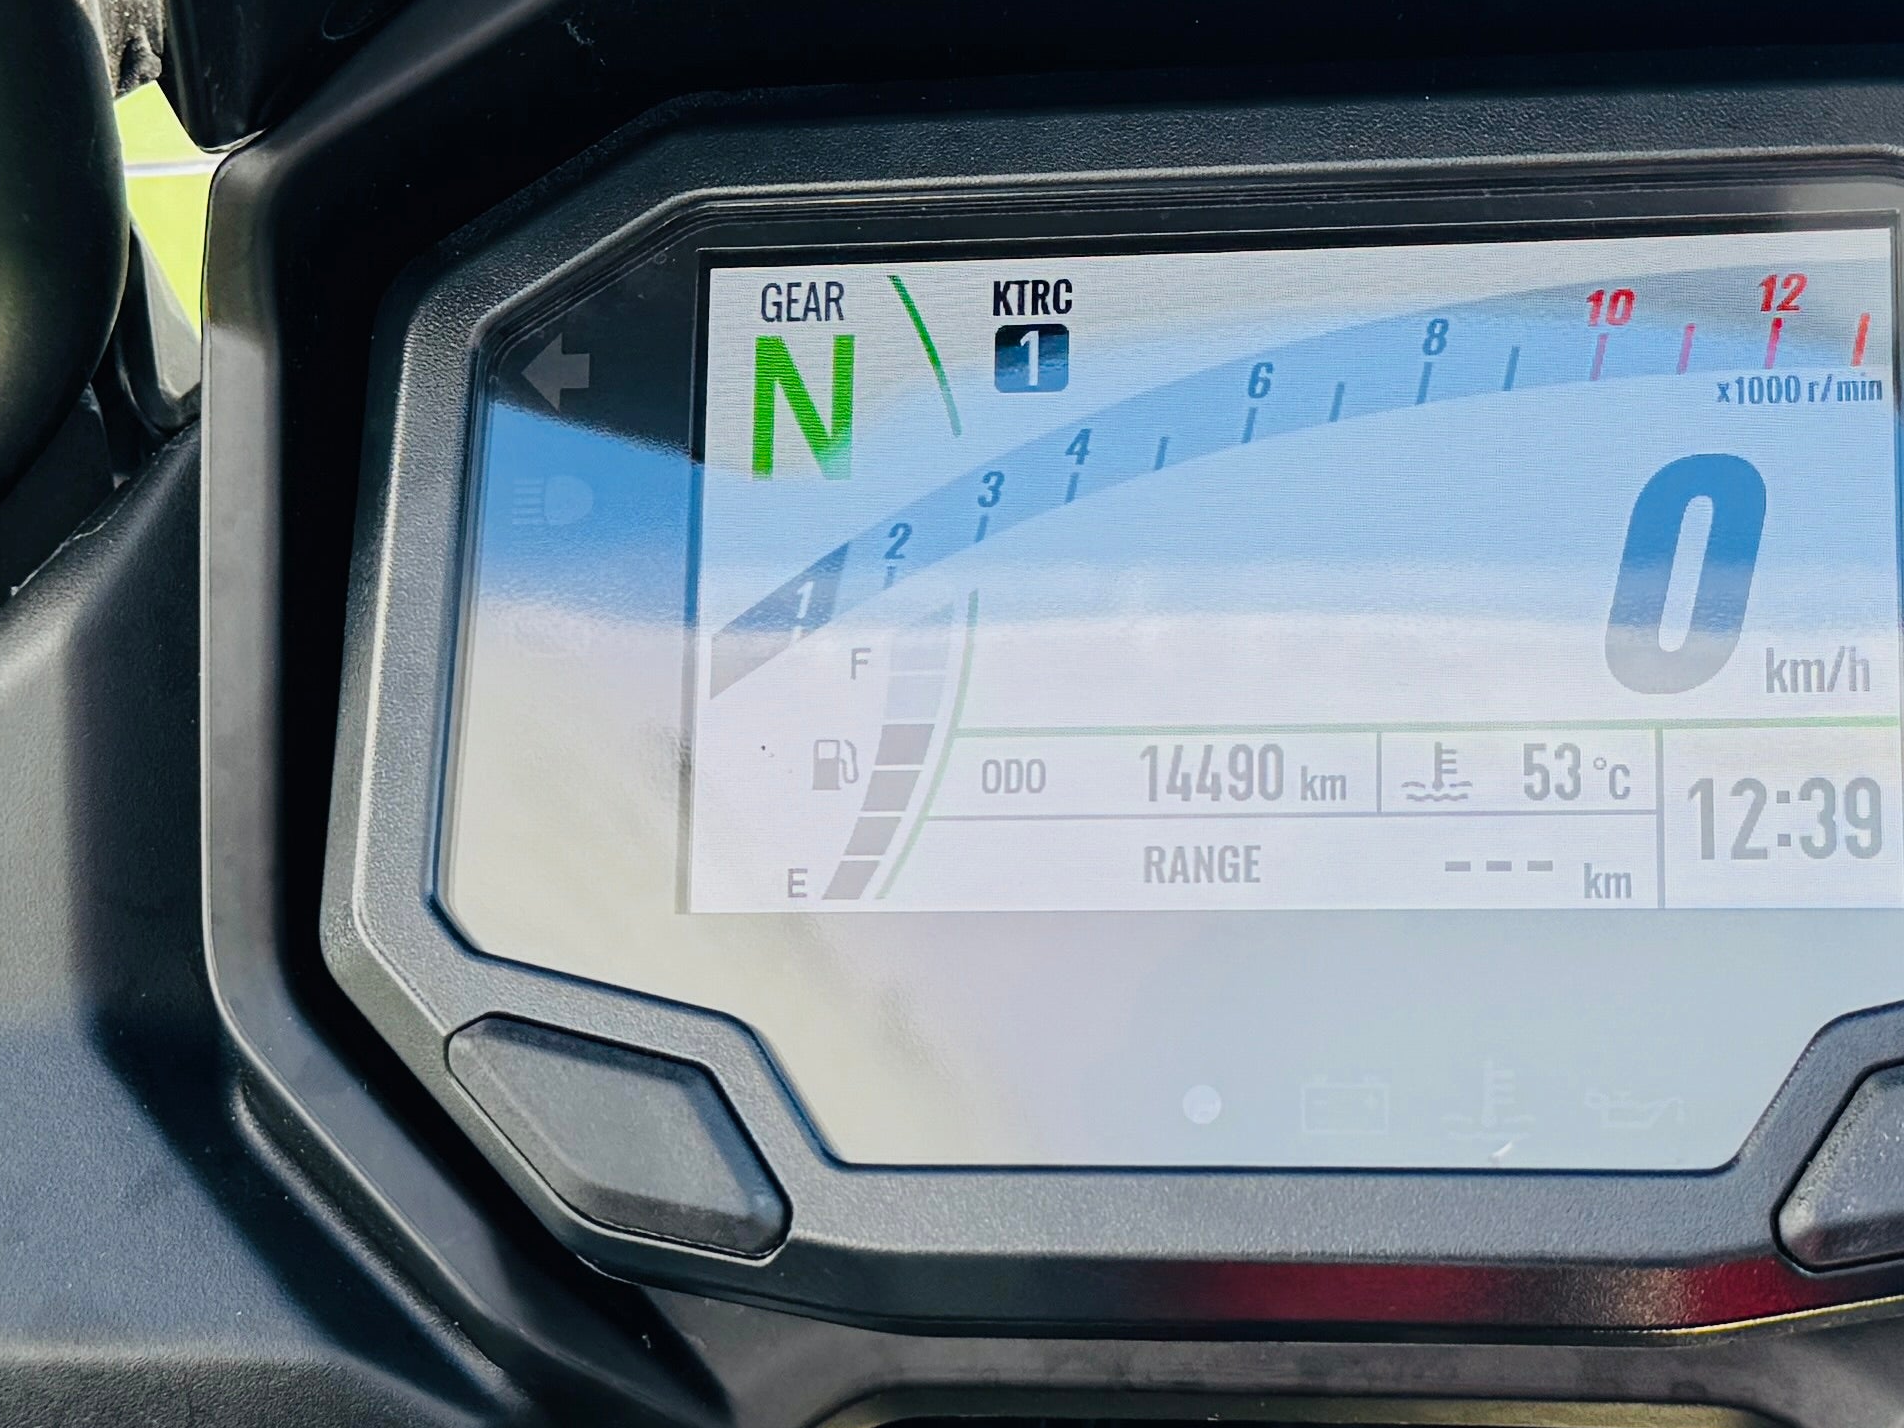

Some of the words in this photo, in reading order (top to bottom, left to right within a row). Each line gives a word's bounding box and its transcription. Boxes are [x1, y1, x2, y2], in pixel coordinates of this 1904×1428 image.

[760, 281, 846, 323] GEAR
[991, 279, 1074, 317] KTRC
[1586, 289, 1636, 327] 10
[1758, 273, 1808, 312] 12
[1422, 319, 1449, 356] 8
[1019, 330, 1042, 388] 1
[1247, 362, 1274, 399] 6
[1716, 374, 1800, 405] x1000
[1807, 372, 1884, 404] r/min
[752, 334, 856, 480] N
[1066, 428, 1093, 465] 4
[977, 471, 1006, 508] 3
[885, 522, 914, 560] 2
[1604, 451, 1768, 695] 0
[796, 581, 814, 618] 1
[850, 648, 872, 681] F
[1765, 646, 1871, 693] km/h
[981, 758, 1047, 795] ODO
[1140, 742, 1285, 803] 14490
[1300, 765, 1347, 802] km
[1522, 741, 1581, 801] 53
[1687, 777, 1884, 862] 12:39
[787, 868, 809, 900] E
[1143, 845, 1262, 885] RANGE
[1583, 864, 1633, 900] km
